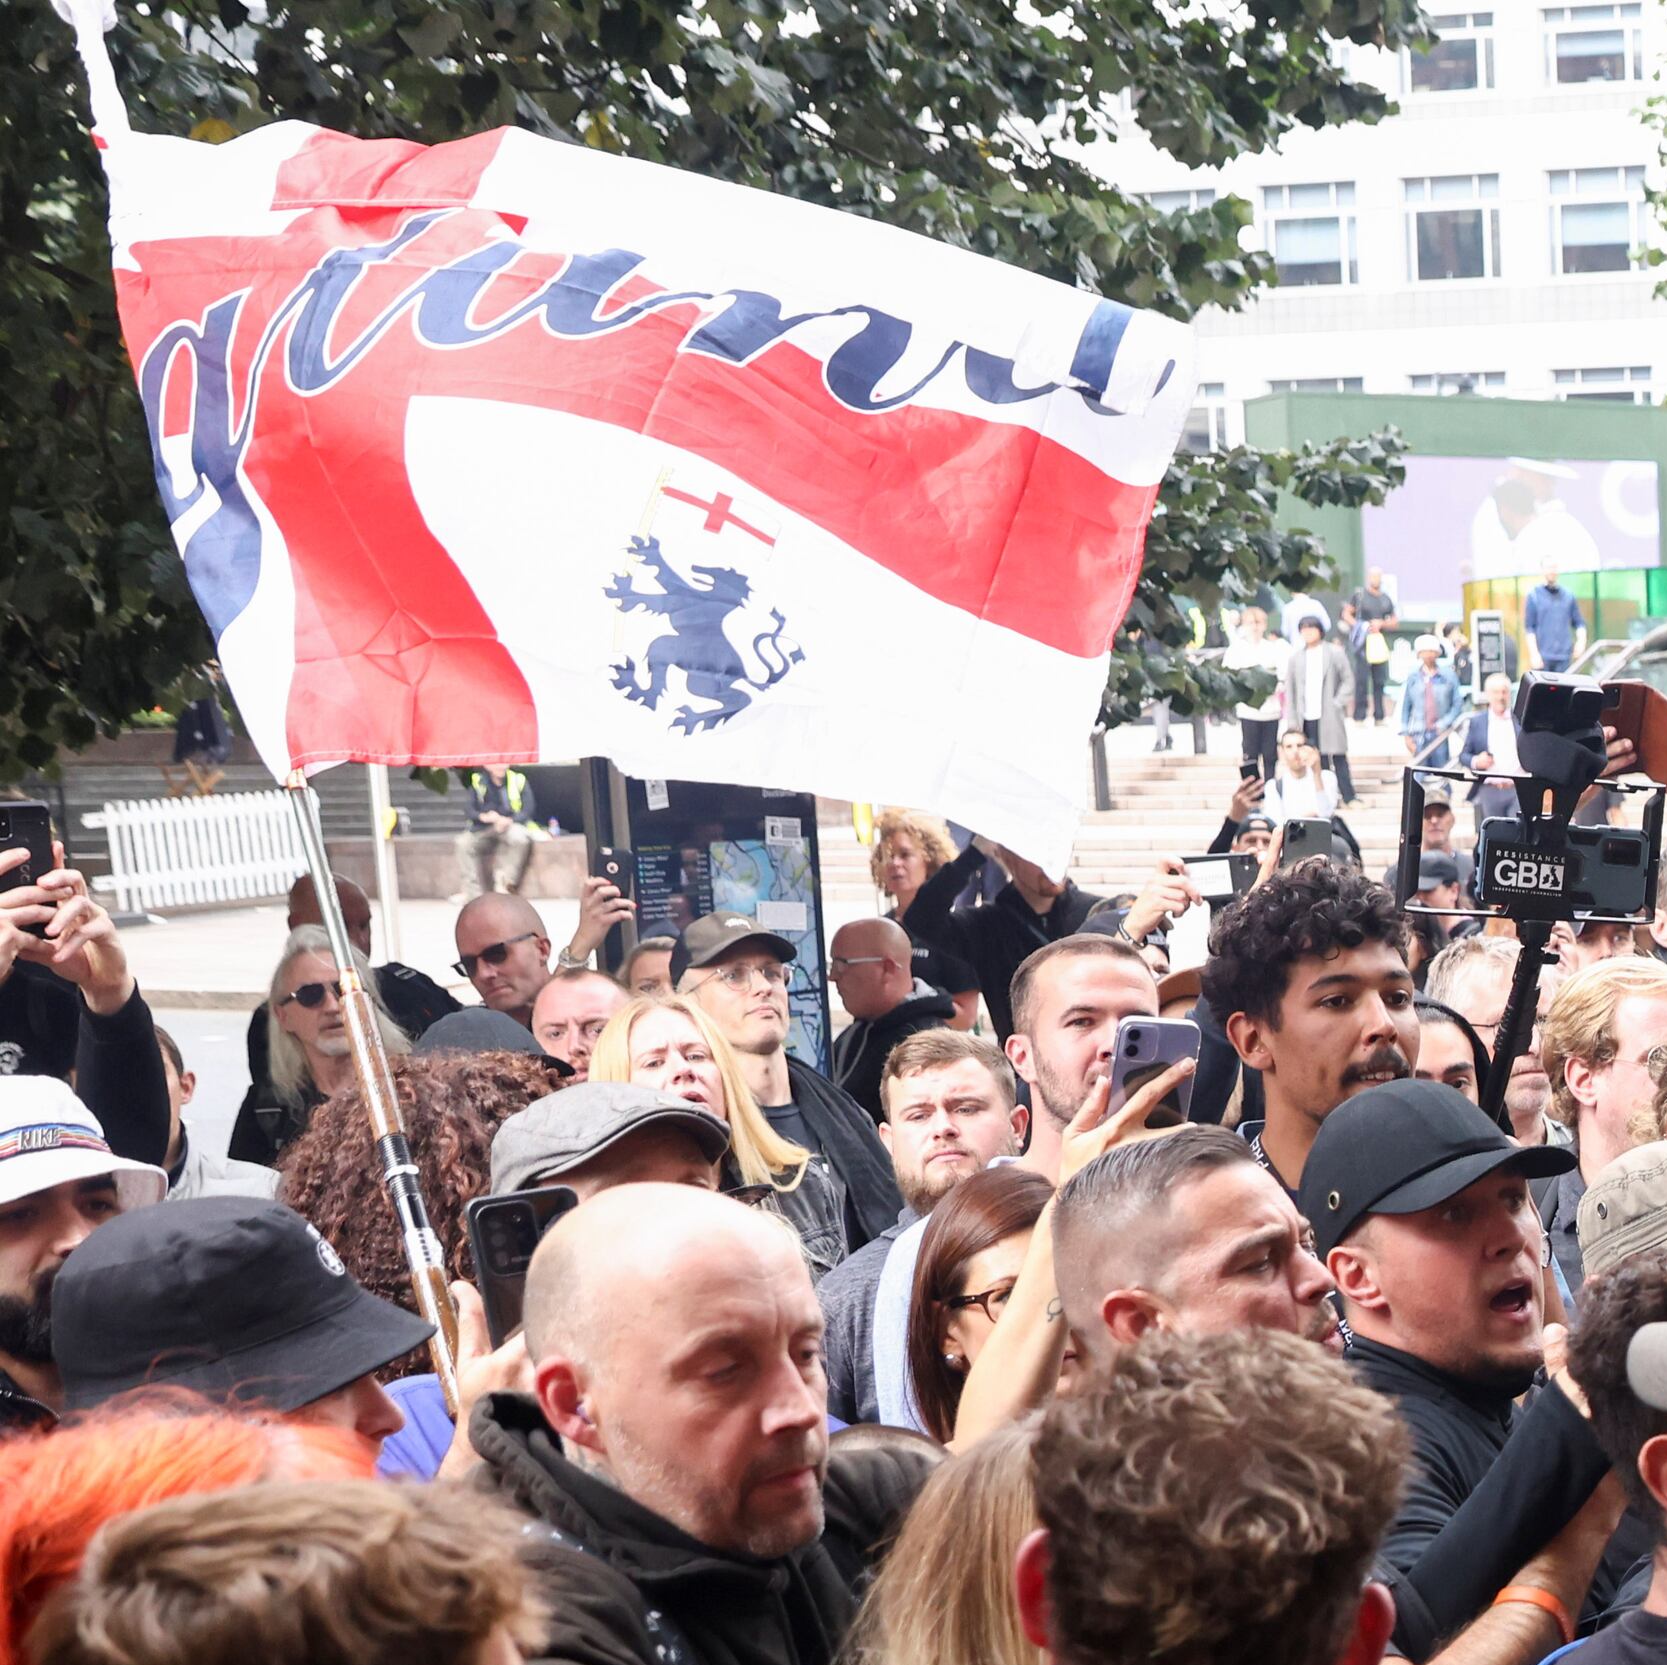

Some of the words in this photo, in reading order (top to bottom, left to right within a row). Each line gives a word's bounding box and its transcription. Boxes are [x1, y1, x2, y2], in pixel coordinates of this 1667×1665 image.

[1495, 849, 1566, 864] RESISTANCE
[1493, 859, 1538, 888] GB
[1492, 886, 1528, 894] INDEPENDENT
[19, 1127, 63, 1151] NIKE
